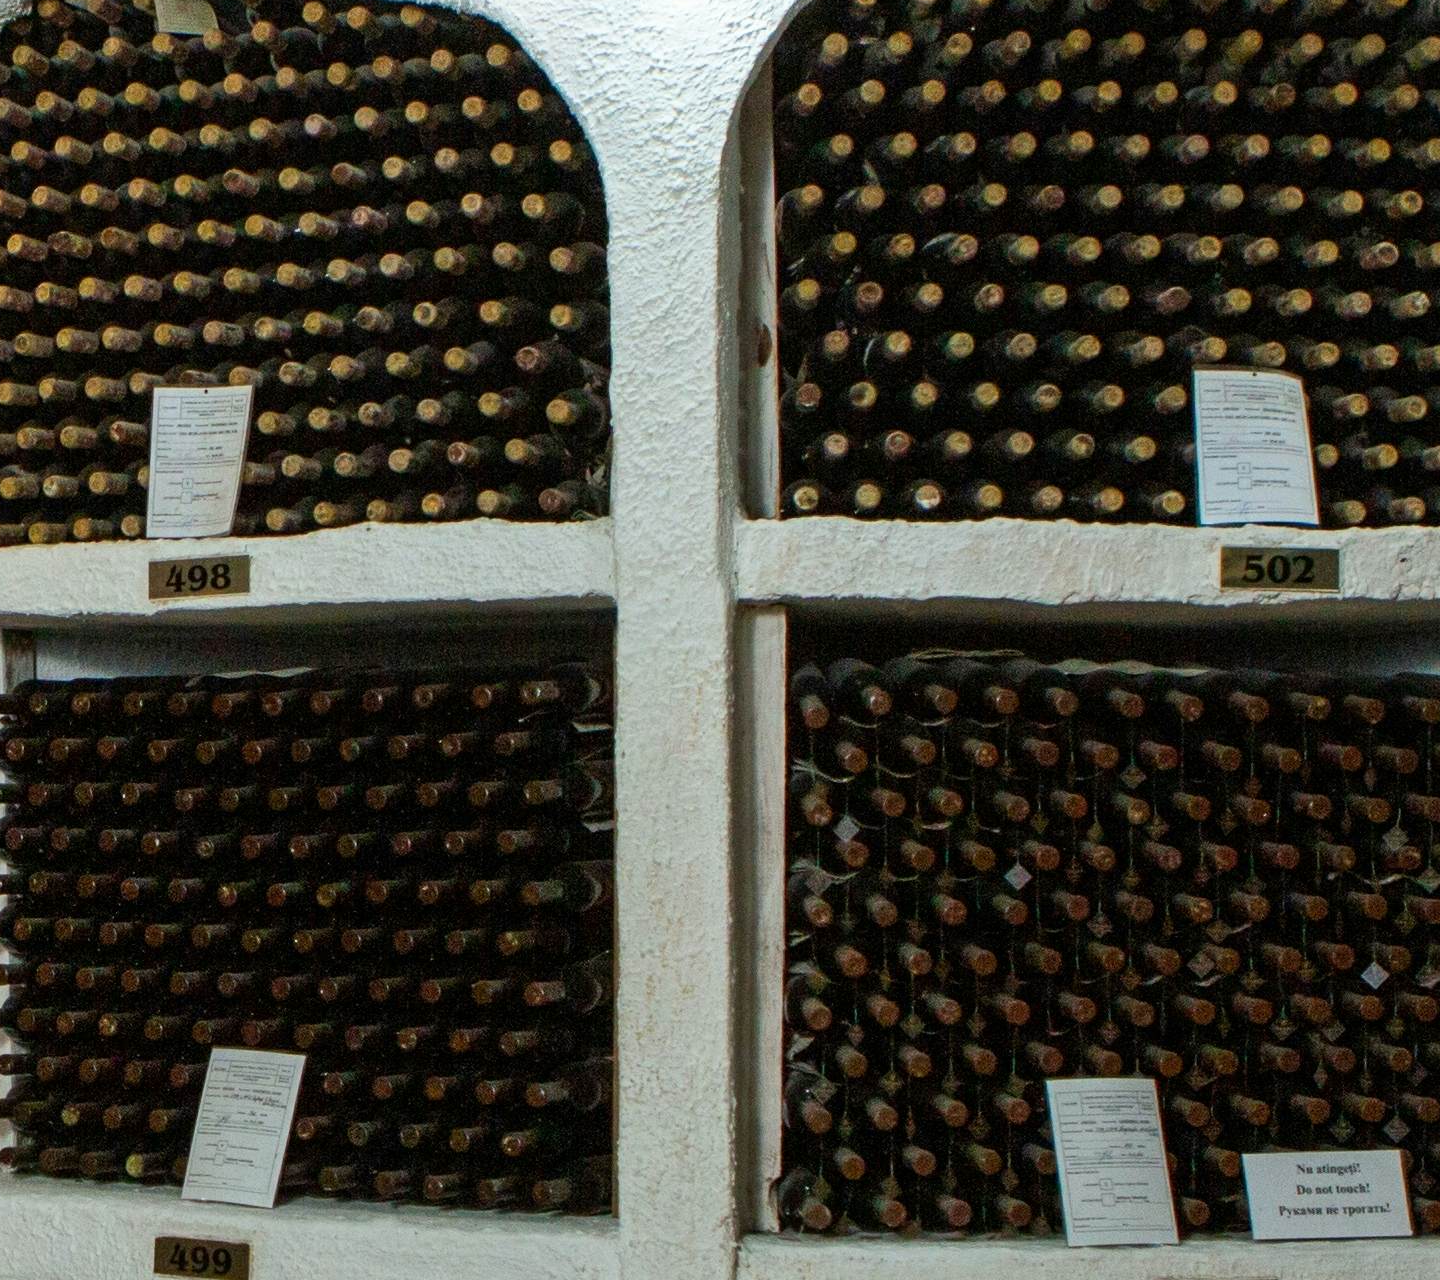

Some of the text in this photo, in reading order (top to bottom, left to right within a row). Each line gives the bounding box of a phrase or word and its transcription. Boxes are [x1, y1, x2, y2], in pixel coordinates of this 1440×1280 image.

[165, 563, 232, 594] 498
[1241, 554, 1315, 585] 502
[1296, 1163, 1313, 1175] Nu
[1296, 1183, 1370, 1196] Do not touch!
[1278, 1203, 1392, 1219] Руками не трогать!
[170, 1243, 232, 1276] 499
